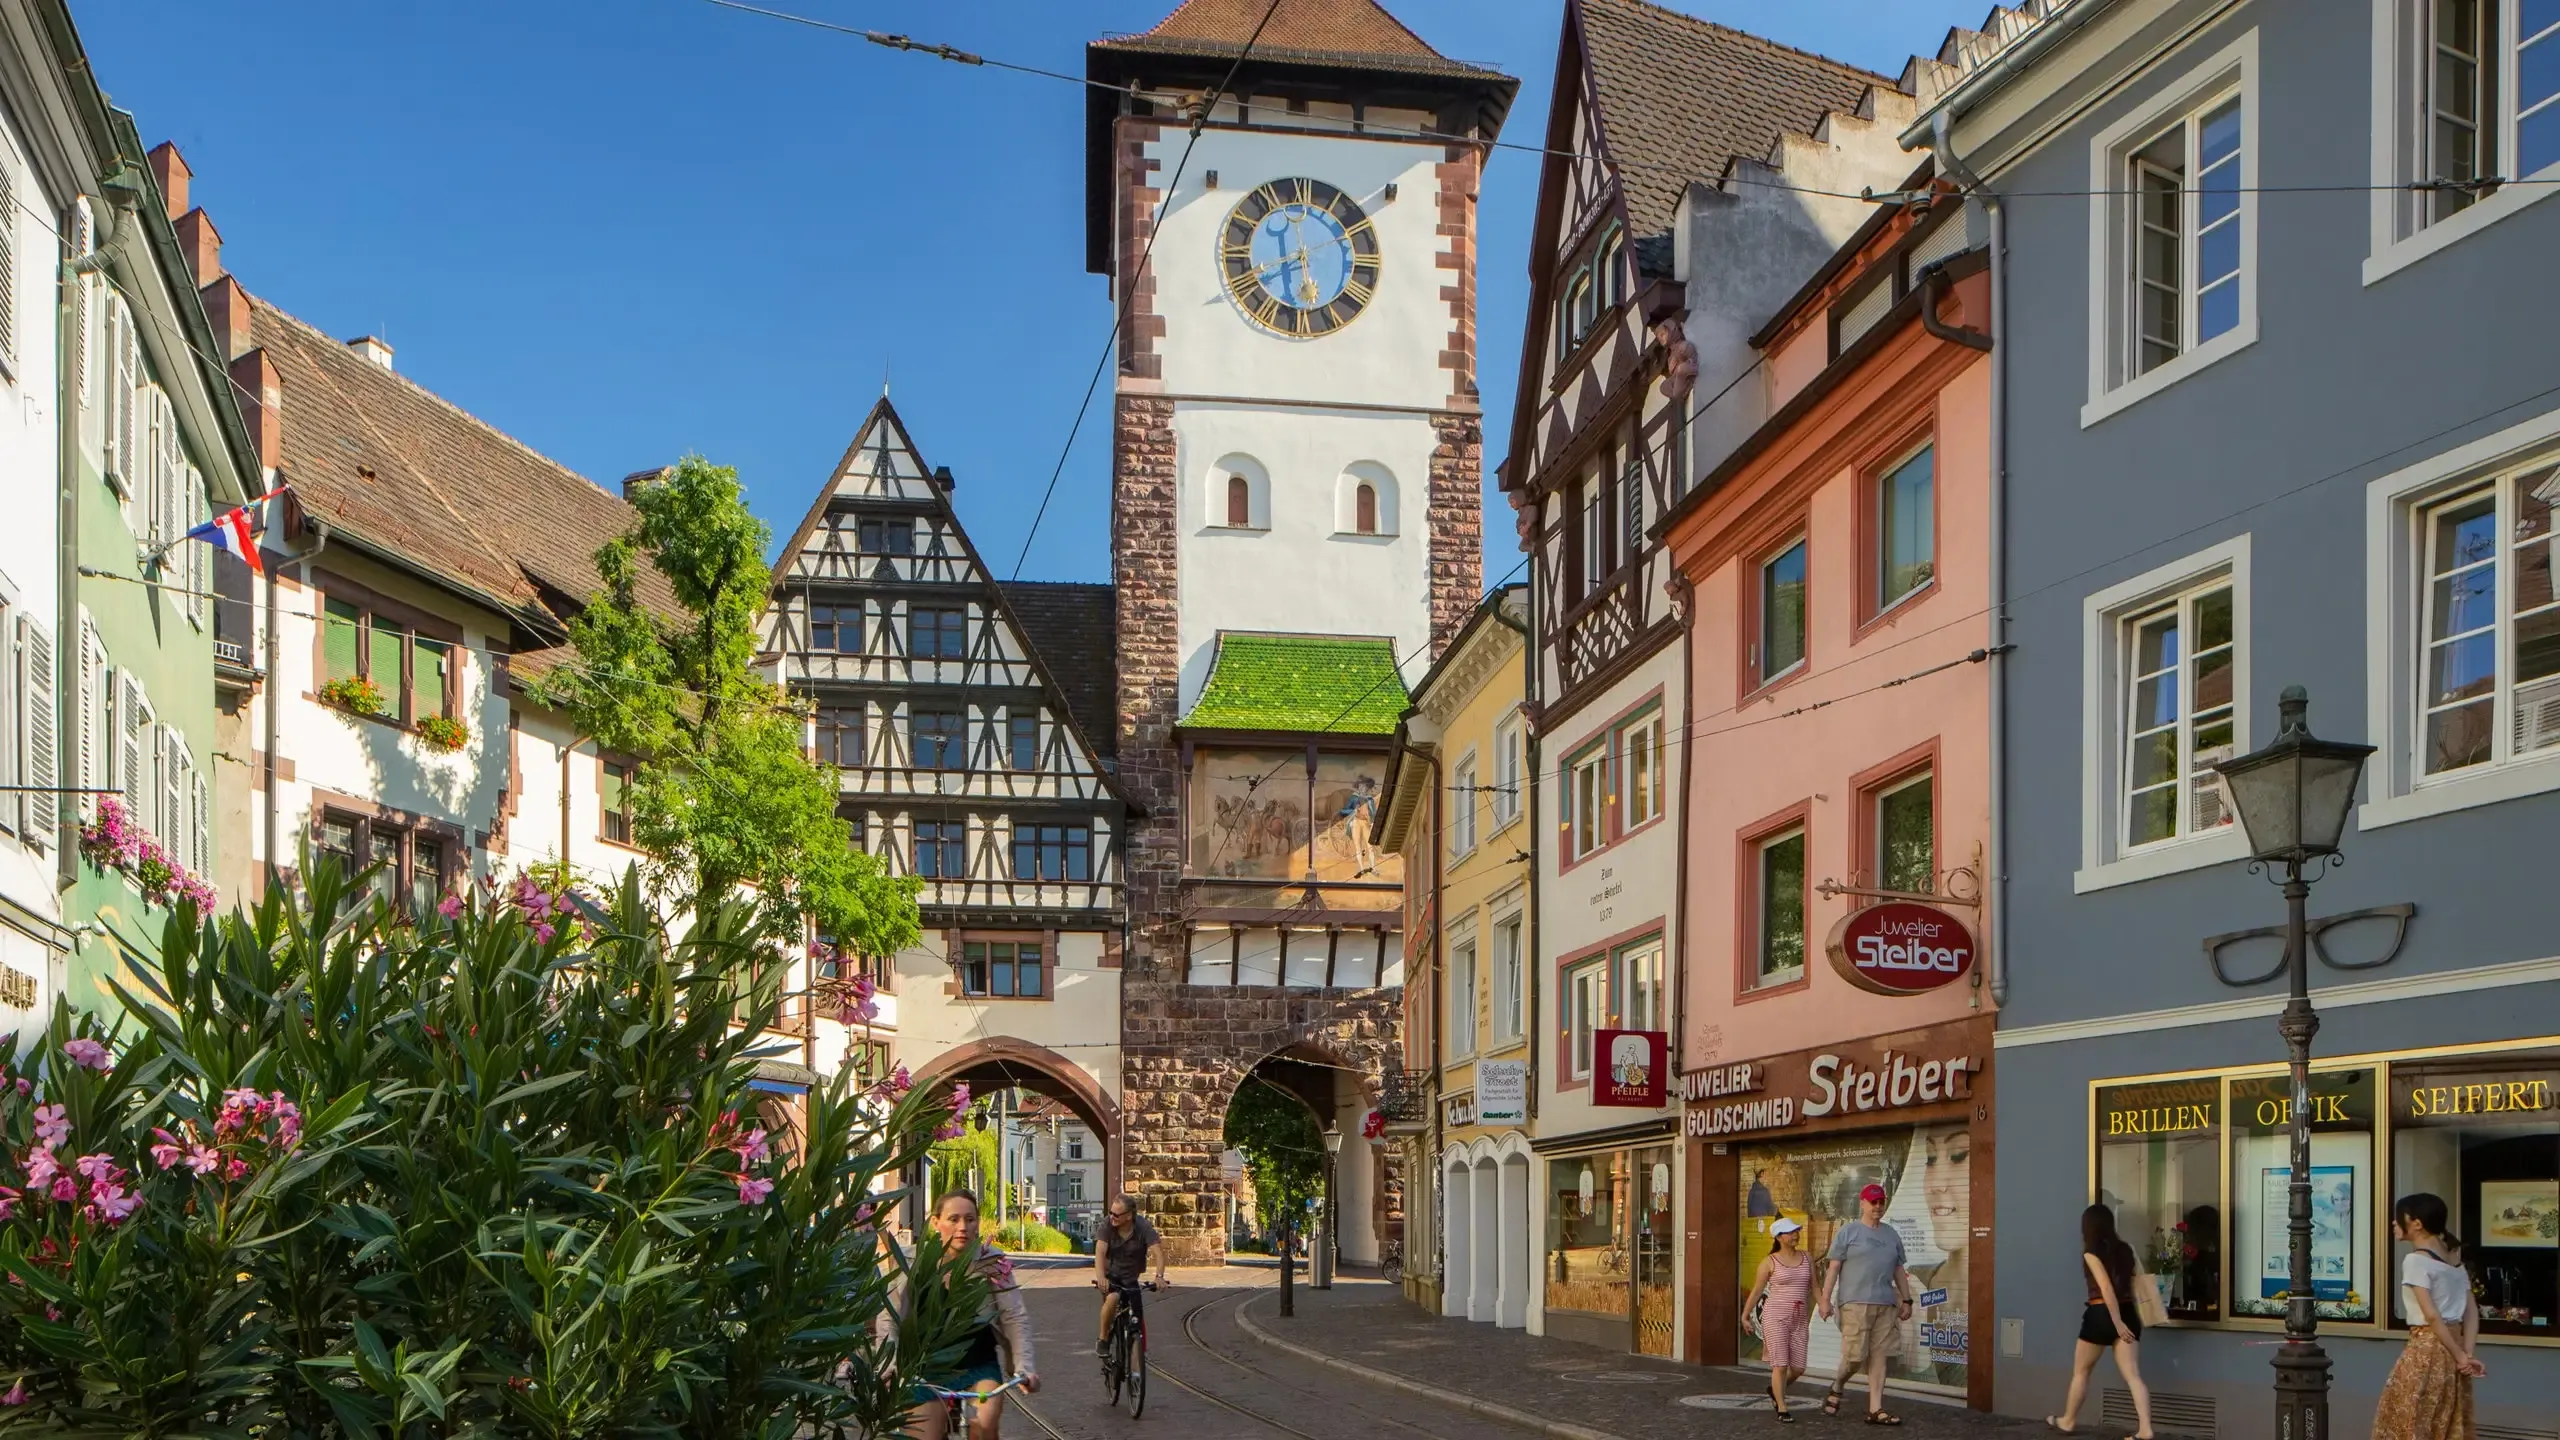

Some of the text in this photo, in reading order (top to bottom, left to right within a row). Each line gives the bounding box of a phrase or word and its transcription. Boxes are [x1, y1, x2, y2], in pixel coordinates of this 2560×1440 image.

[1293, 178, 1312, 204] XII
[1346, 219, 1371, 236] II
[1355, 254, 1379, 268] III
[1875, 915, 1943, 938] Juwelier
[1856, 936, 1968, 972] Steiber
[1611, 1086, 1649, 1096] PFEIFLE
[1679, 1063, 1752, 1101] JUWELIER
[1802, 1050, 1968, 1116] Steiber
[1975, 1104, 1987, 1121] 16
[2257, 1095, 2350, 1126] OPIK
[2411, 1079, 2549, 1118] SEIFERT
[1687, 1096, 1794, 1137] GOLDSCHMIED
[2109, 1104, 2212, 1135] BRILLEN
